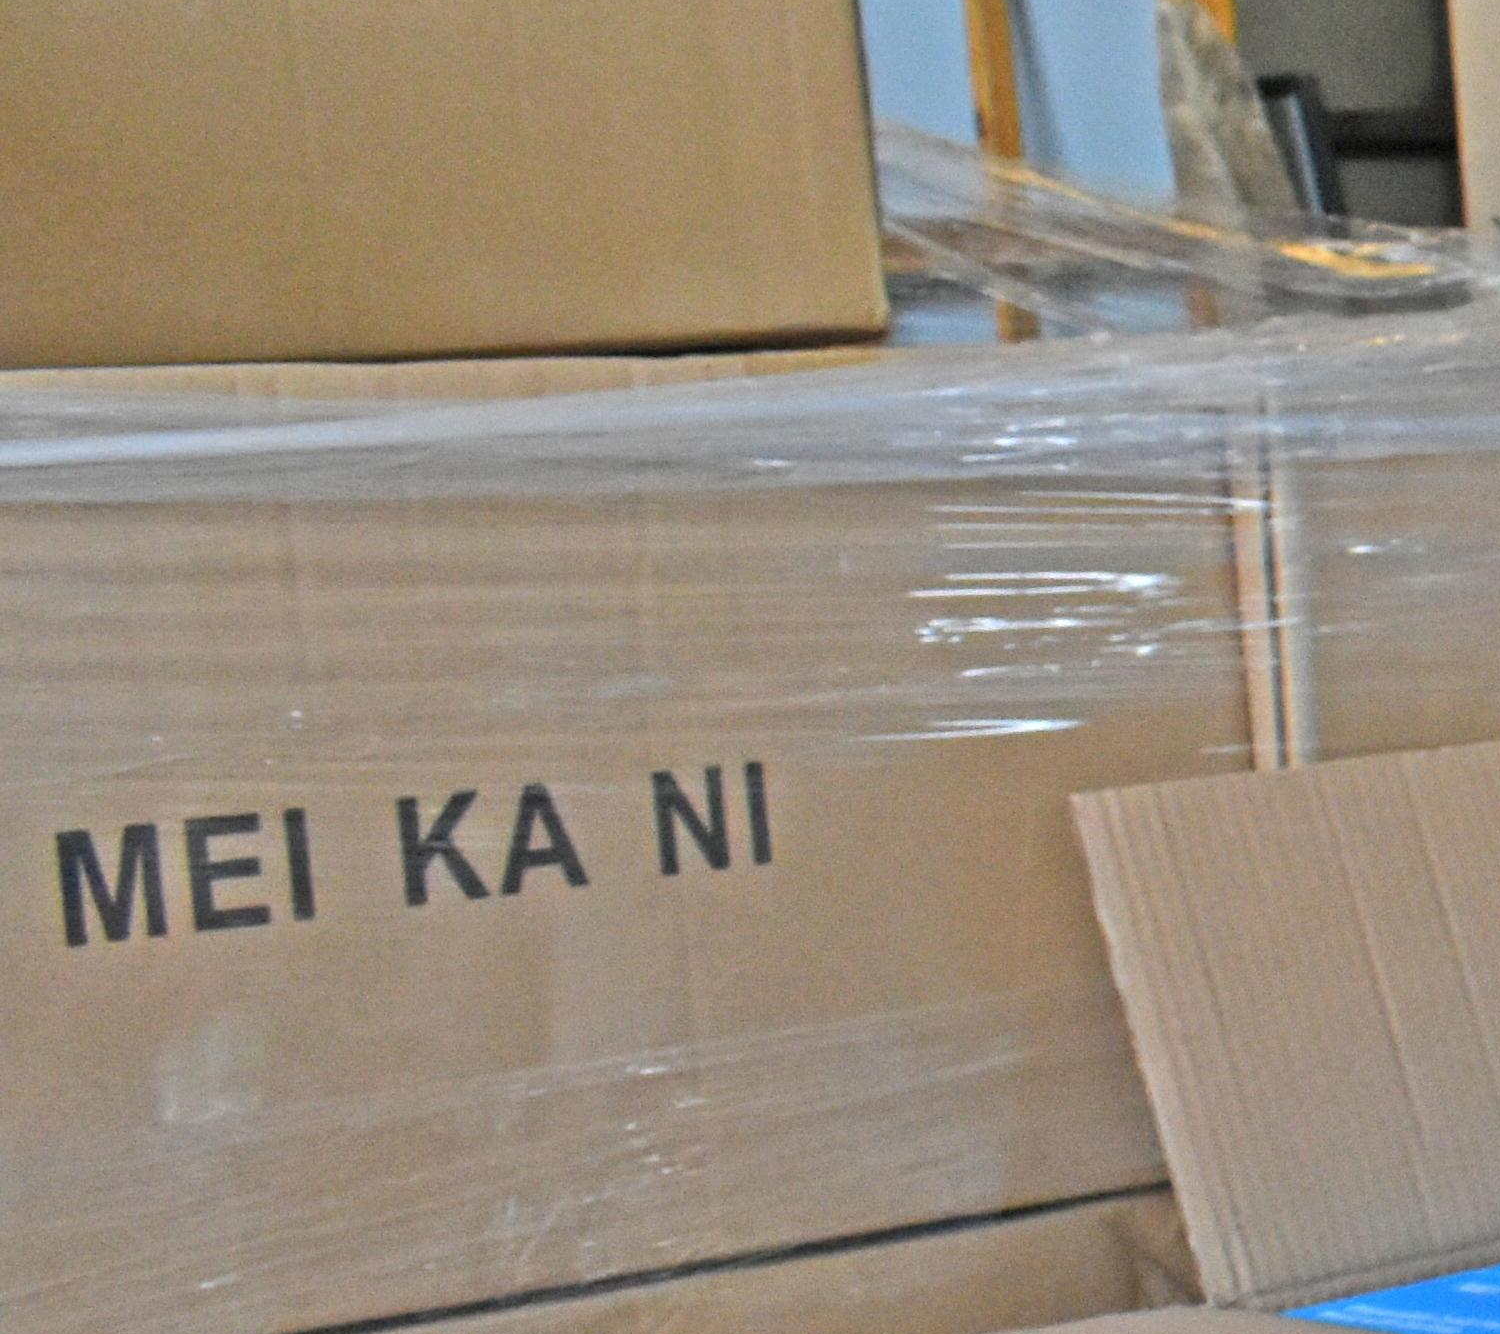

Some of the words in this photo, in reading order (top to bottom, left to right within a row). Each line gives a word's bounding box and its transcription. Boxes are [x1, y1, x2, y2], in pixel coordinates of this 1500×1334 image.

[55, 805, 317, 948] MEI
[394, 782, 590, 907] KA
[651, 760, 774, 877] NI
